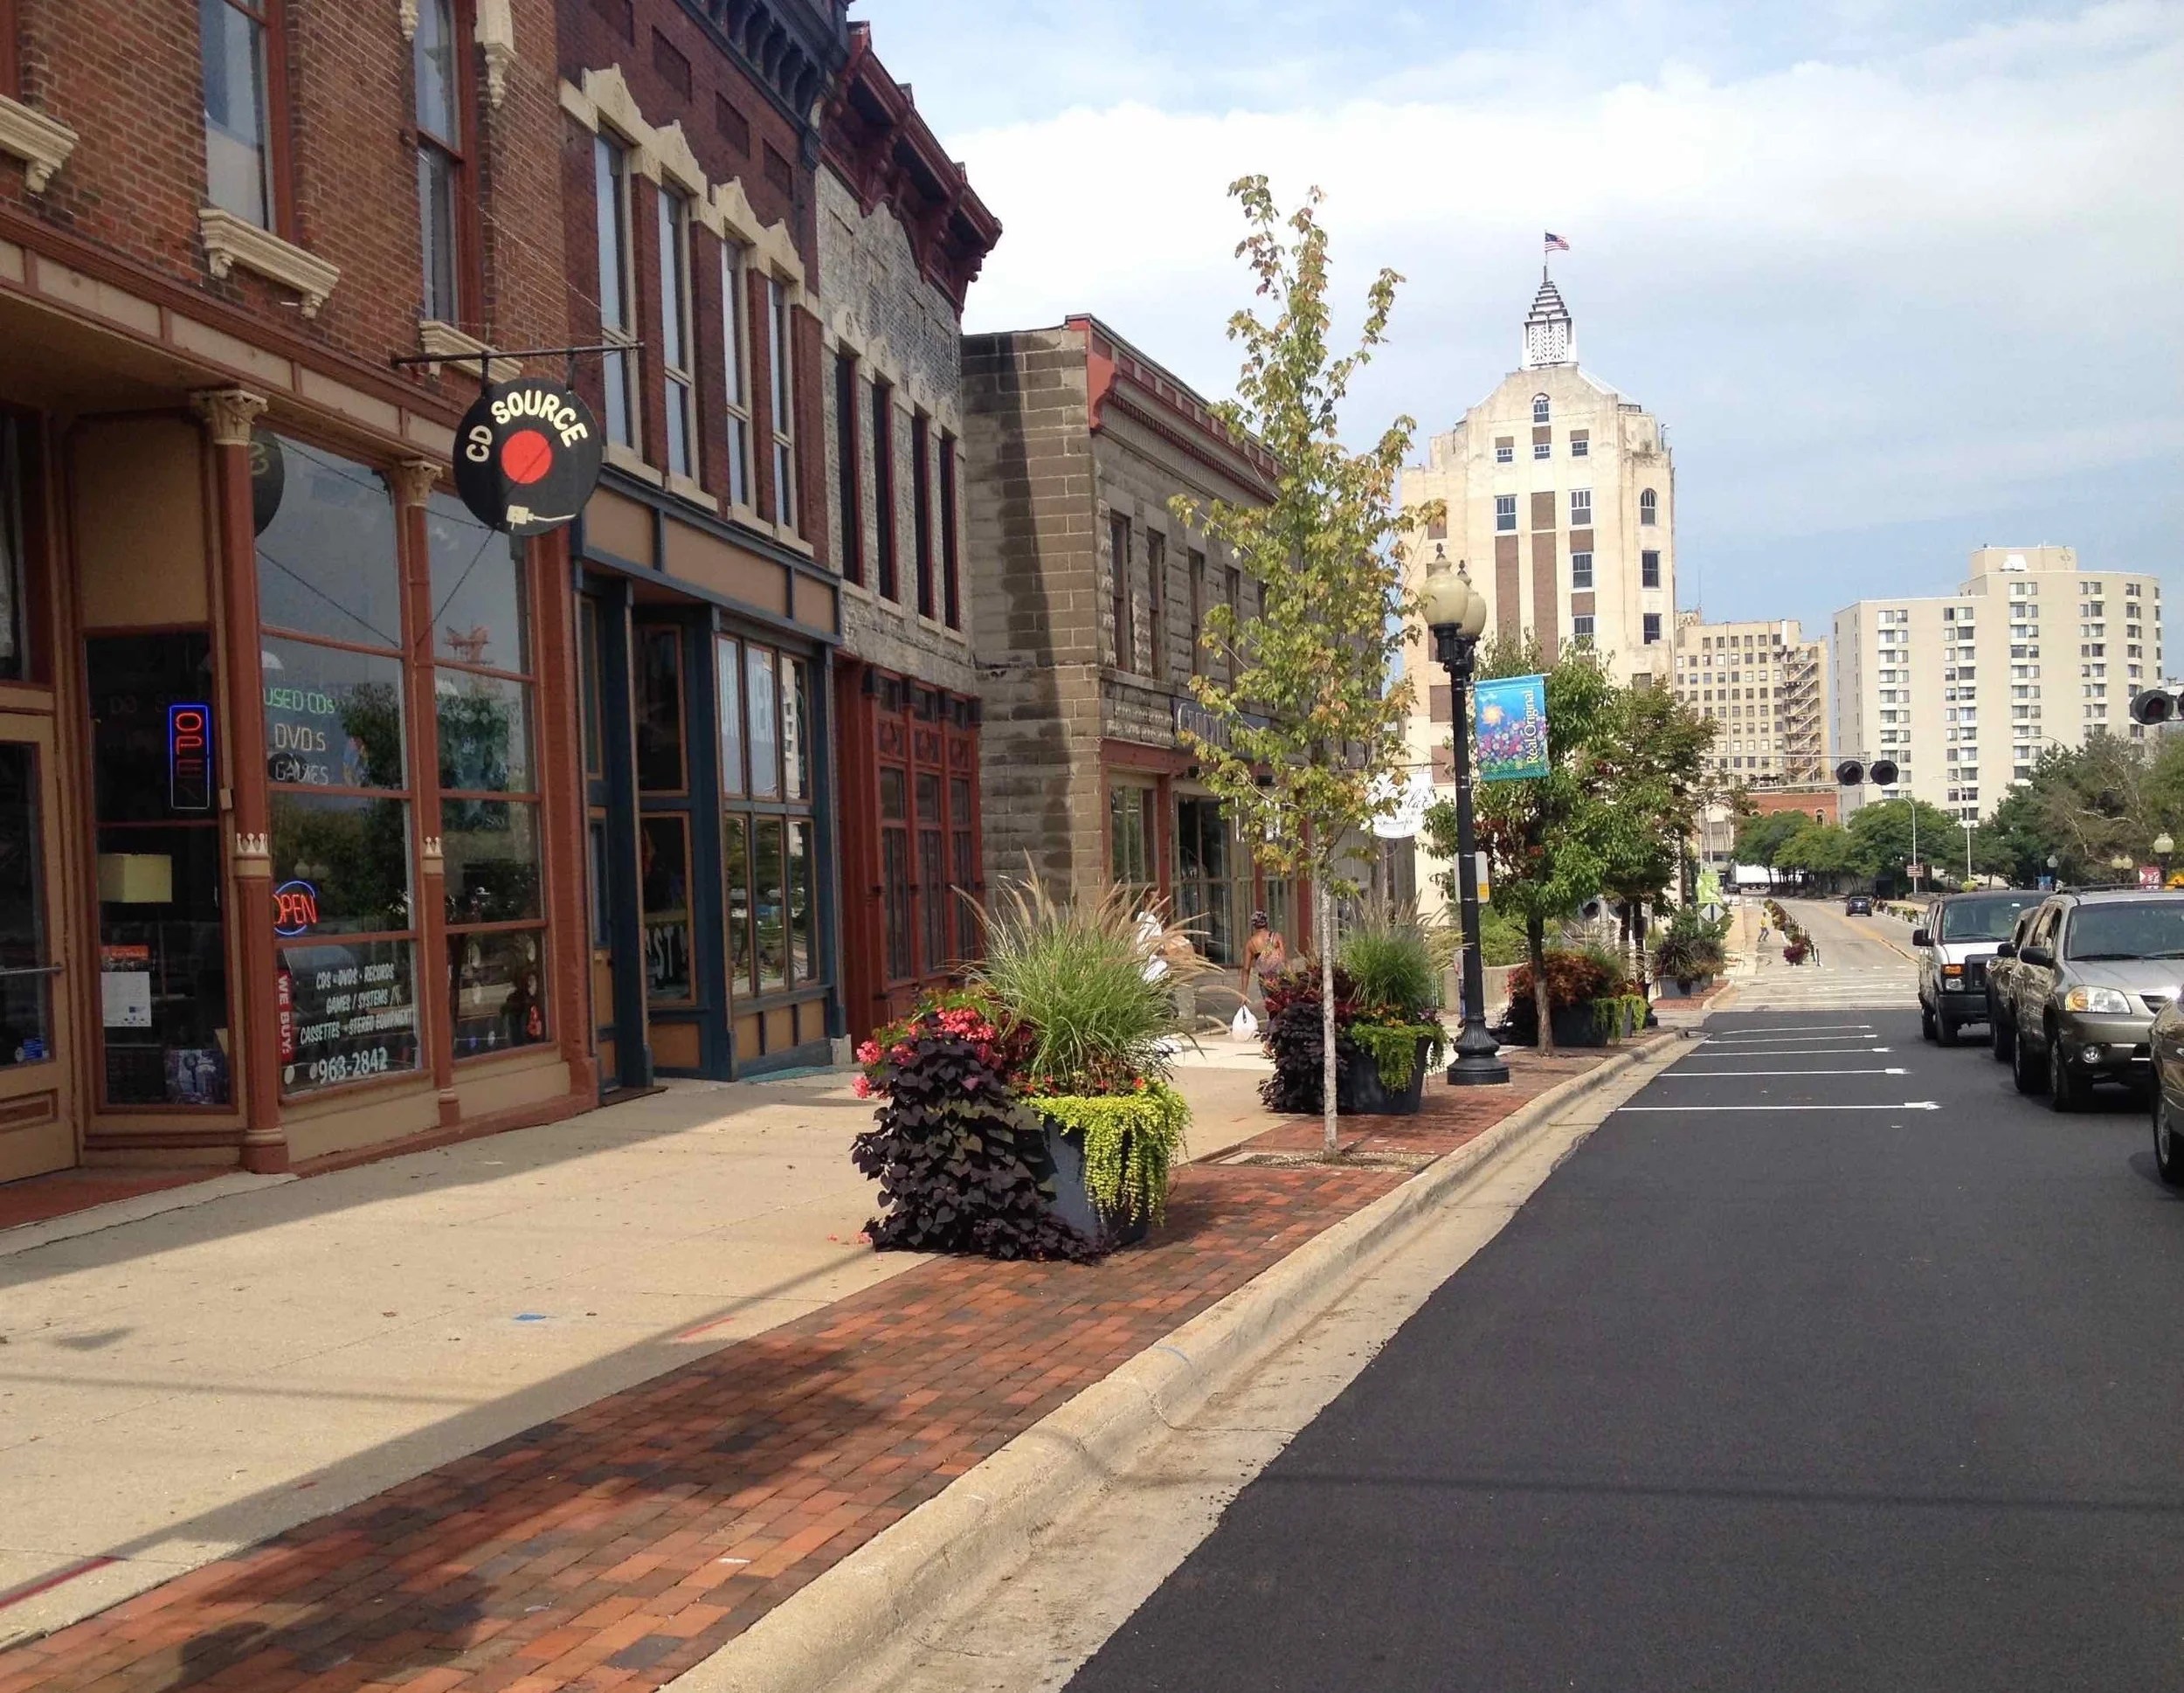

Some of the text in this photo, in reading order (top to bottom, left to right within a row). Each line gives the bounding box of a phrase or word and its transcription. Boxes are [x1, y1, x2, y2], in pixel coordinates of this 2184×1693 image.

[466, 389, 588, 462] CD SOURCE
[263, 688, 304, 712] USED
[363, 963, 395, 983] RECORDS
[279, 975, 289, 1005] WE
[326, 994, 350, 1015] GAMES
[358, 988, 389, 1009] SYSTEMS
[300, 1009, 412, 1046] CASSETTES STEREO EQUIPMENT
[318, 1046, 389, 1085] 963-2842
